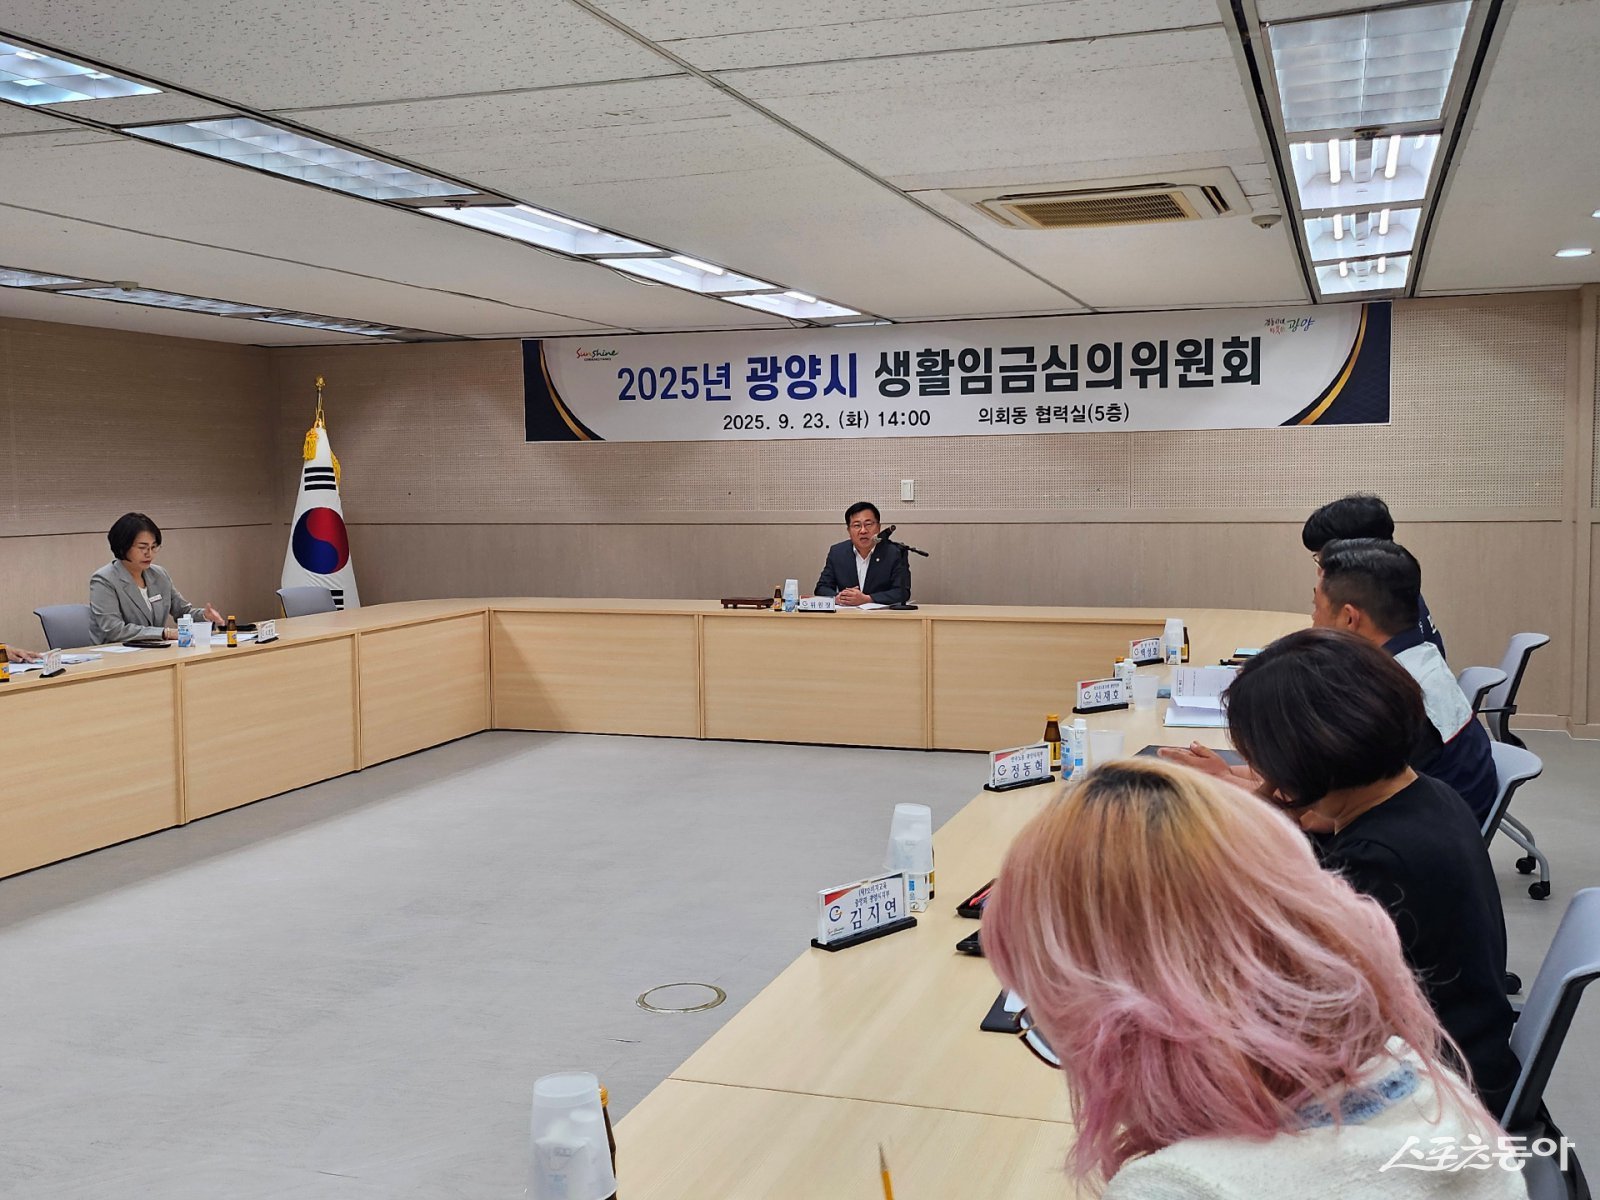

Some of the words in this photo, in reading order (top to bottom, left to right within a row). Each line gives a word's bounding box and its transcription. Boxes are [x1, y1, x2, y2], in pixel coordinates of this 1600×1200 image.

[1286, 316, 1316, 333] 광양
[617, 362, 732, 402] 2025년
[745, 352, 858, 402] 광양시
[874, 335, 1262, 399] 생활임금심의위원회
[723, 413, 770, 431] 2025.
[778, 413, 795, 430] 9.
[802, 411, 830, 430] 23.
[838, 409, 870, 430] (화)
[878, 409, 931, 428] 14:00
[978, 405, 1028, 426] 의회동
[1035, 402, 1130, 425] 협력실(5층)
[1094, 689, 1120, 703] 신재호
[1011, 758, 1044, 779] 정동혁
[850, 897, 898, 931] 김지연
